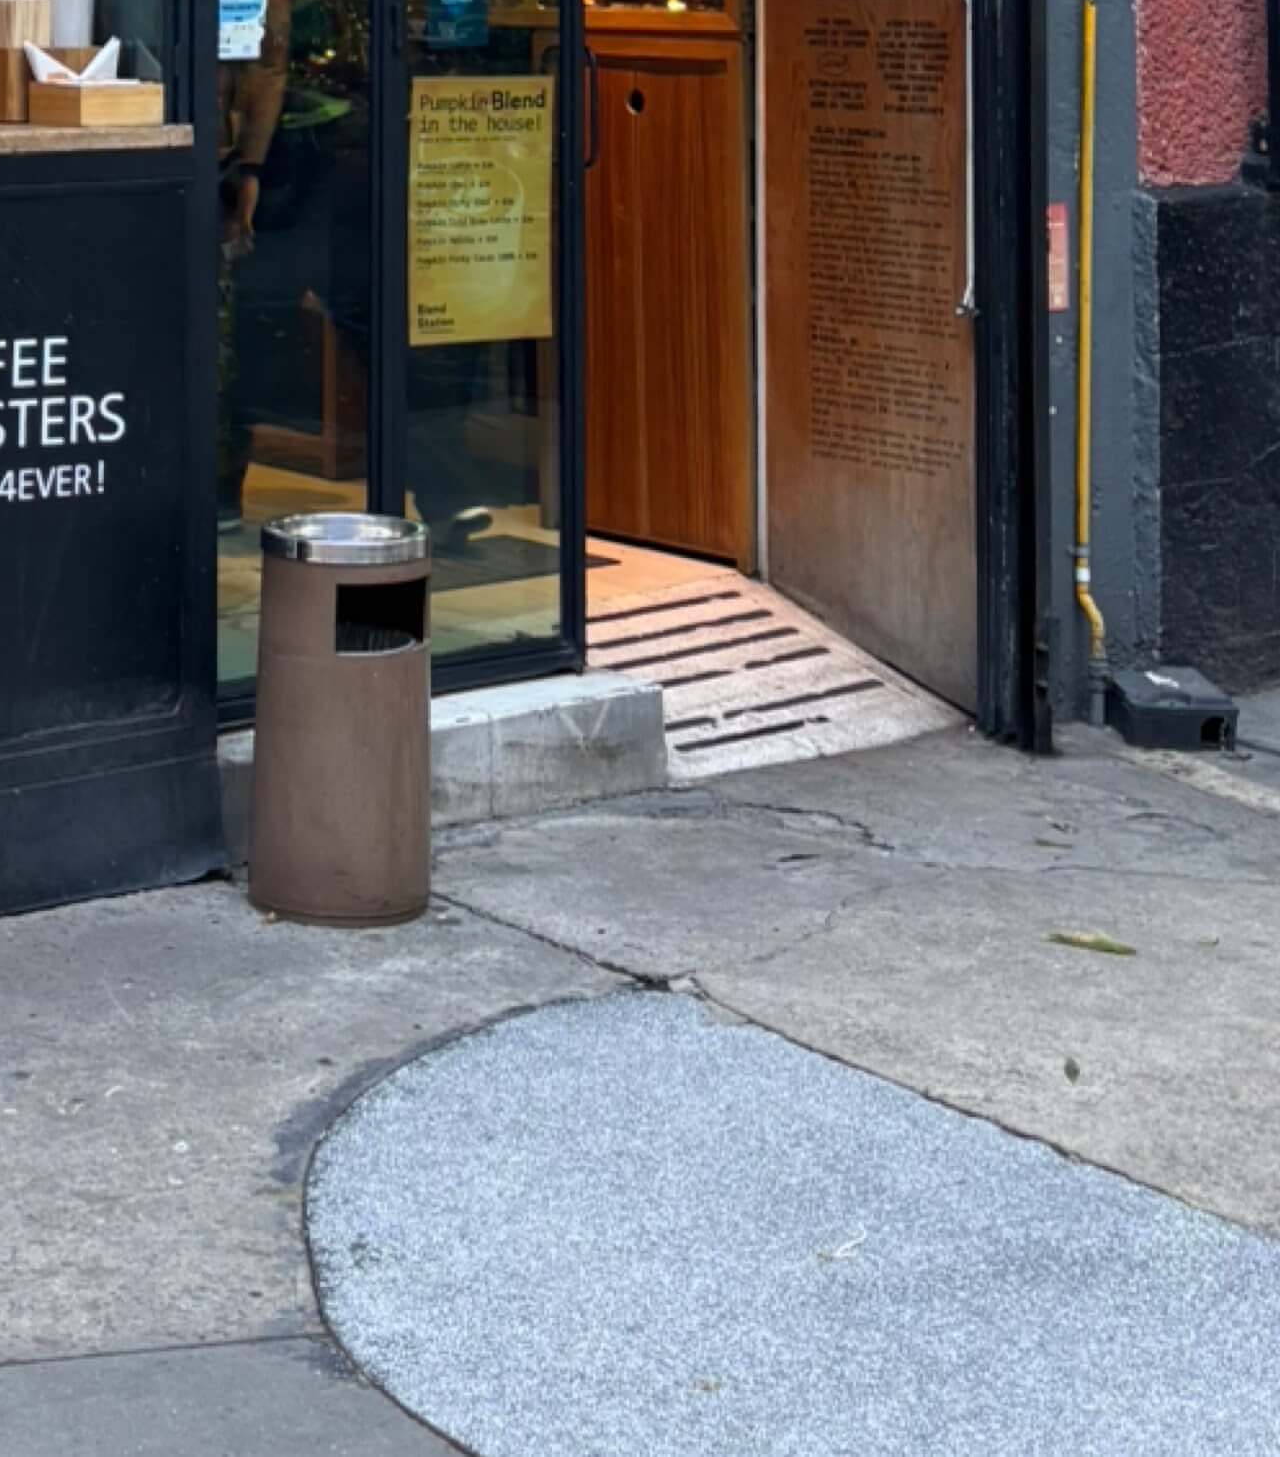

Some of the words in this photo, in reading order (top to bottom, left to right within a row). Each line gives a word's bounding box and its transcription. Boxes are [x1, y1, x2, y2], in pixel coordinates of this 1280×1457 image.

[420, 92, 488, 114] Pumpkin
[490, 88, 545, 111] Blend
[419, 116, 439, 133] in
[448, 115, 478, 133] the
[487, 114, 542, 133] house!
